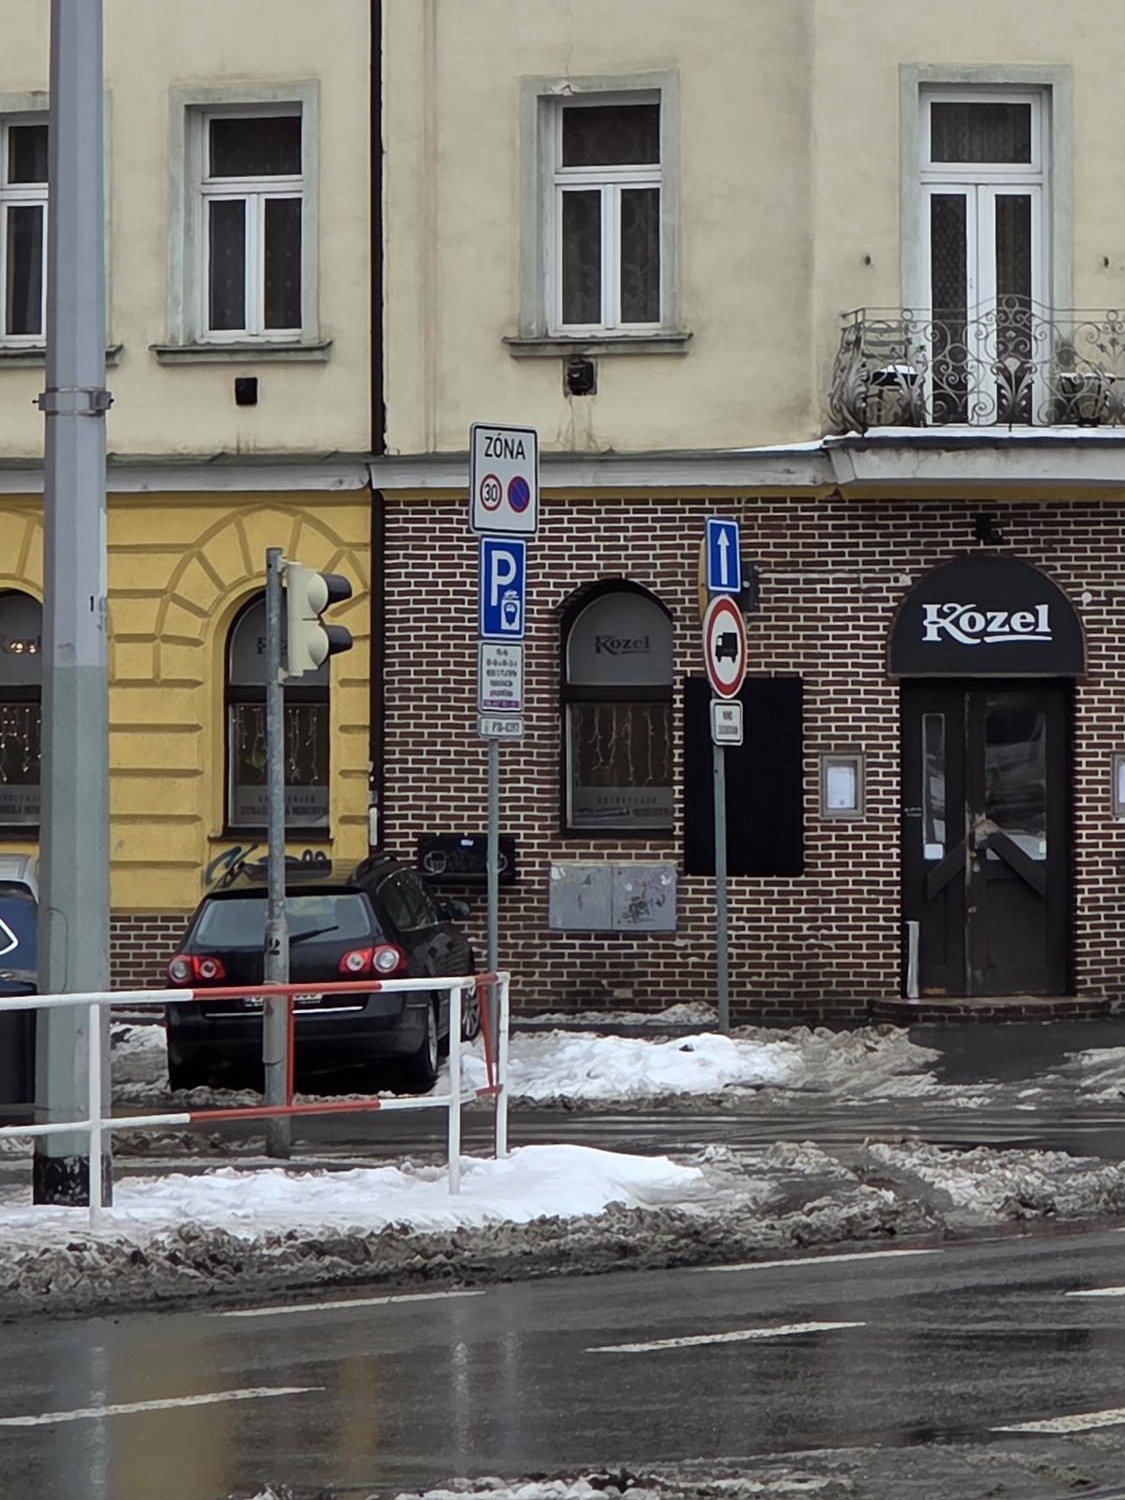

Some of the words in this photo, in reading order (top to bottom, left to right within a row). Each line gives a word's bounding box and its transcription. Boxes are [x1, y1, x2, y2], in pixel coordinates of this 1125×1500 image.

[484, 432, 526, 460] ZÓNA
[484, 483, 498, 502] 30
[490, 550, 517, 606] P
[922, 603, 1053, 644] Kozel
[595, 634, 650, 655] Kozel
